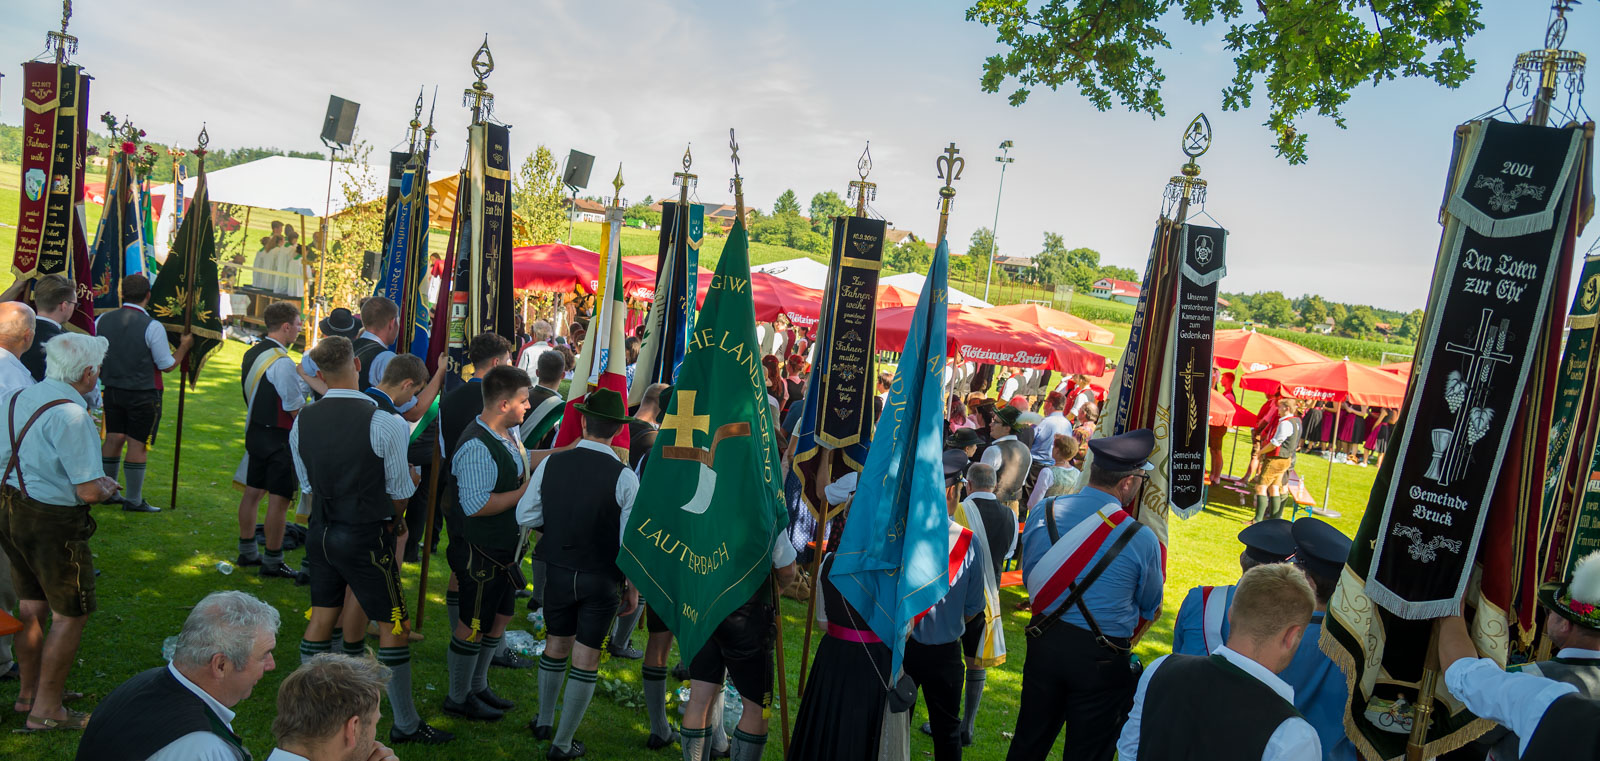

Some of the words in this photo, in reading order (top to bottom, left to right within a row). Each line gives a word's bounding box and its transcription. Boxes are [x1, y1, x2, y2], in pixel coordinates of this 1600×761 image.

[1500, 161, 1535, 179] 2001
[1462, 248, 1493, 273] Den
[1495, 254, 1537, 280] Toten
[851, 275, 866, 287] Zur
[1462, 277, 1492, 297] zur
[841, 284, 873, 300] Fahnen-
[1186, 292, 1209, 301] Unseren
[845, 299, 867, 311] weihe
[1181, 303, 1214, 312] verstorbenen
[1181, 312, 1211, 321] Kameraden
[1180, 330, 1210, 340] Gedenken
[835, 340, 866, 353] Fahnen-
[838, 353, 861, 362] mutter
[960, 345, 1014, 362] Flötzinger
[1013, 350, 1048, 364] Bräu
[1190, 462, 1201, 470] Inn
[1409, 485, 1468, 511] Gemeinde
[1412, 504, 1453, 527] Bruck
[637, 518, 730, 575] LAUTERBACH
